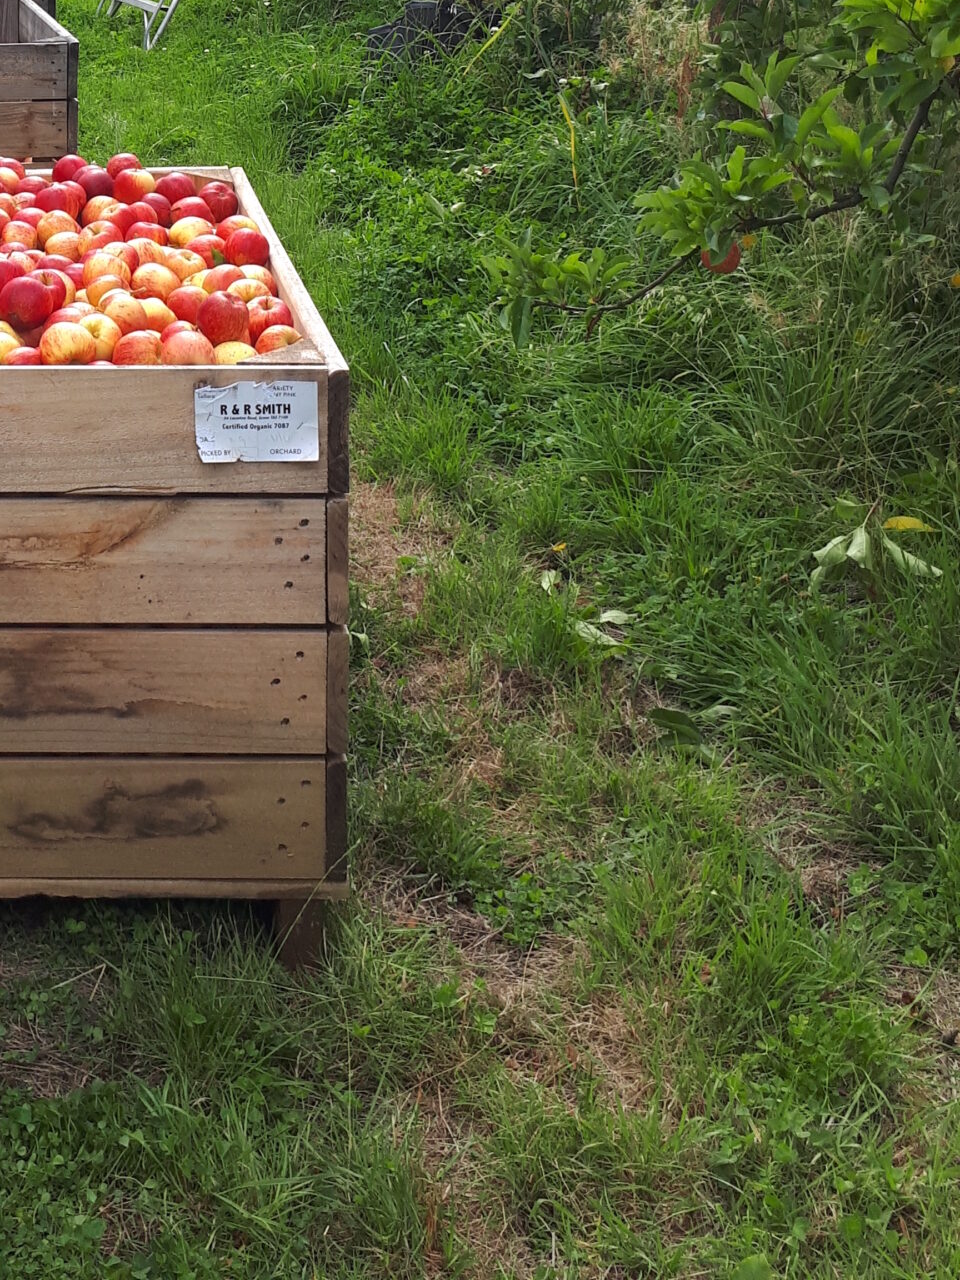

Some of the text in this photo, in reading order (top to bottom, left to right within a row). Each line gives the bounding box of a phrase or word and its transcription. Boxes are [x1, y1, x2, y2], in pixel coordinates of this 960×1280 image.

[220, 403, 291, 415] R & R SMITH
[249, 423, 272, 431] Organic
